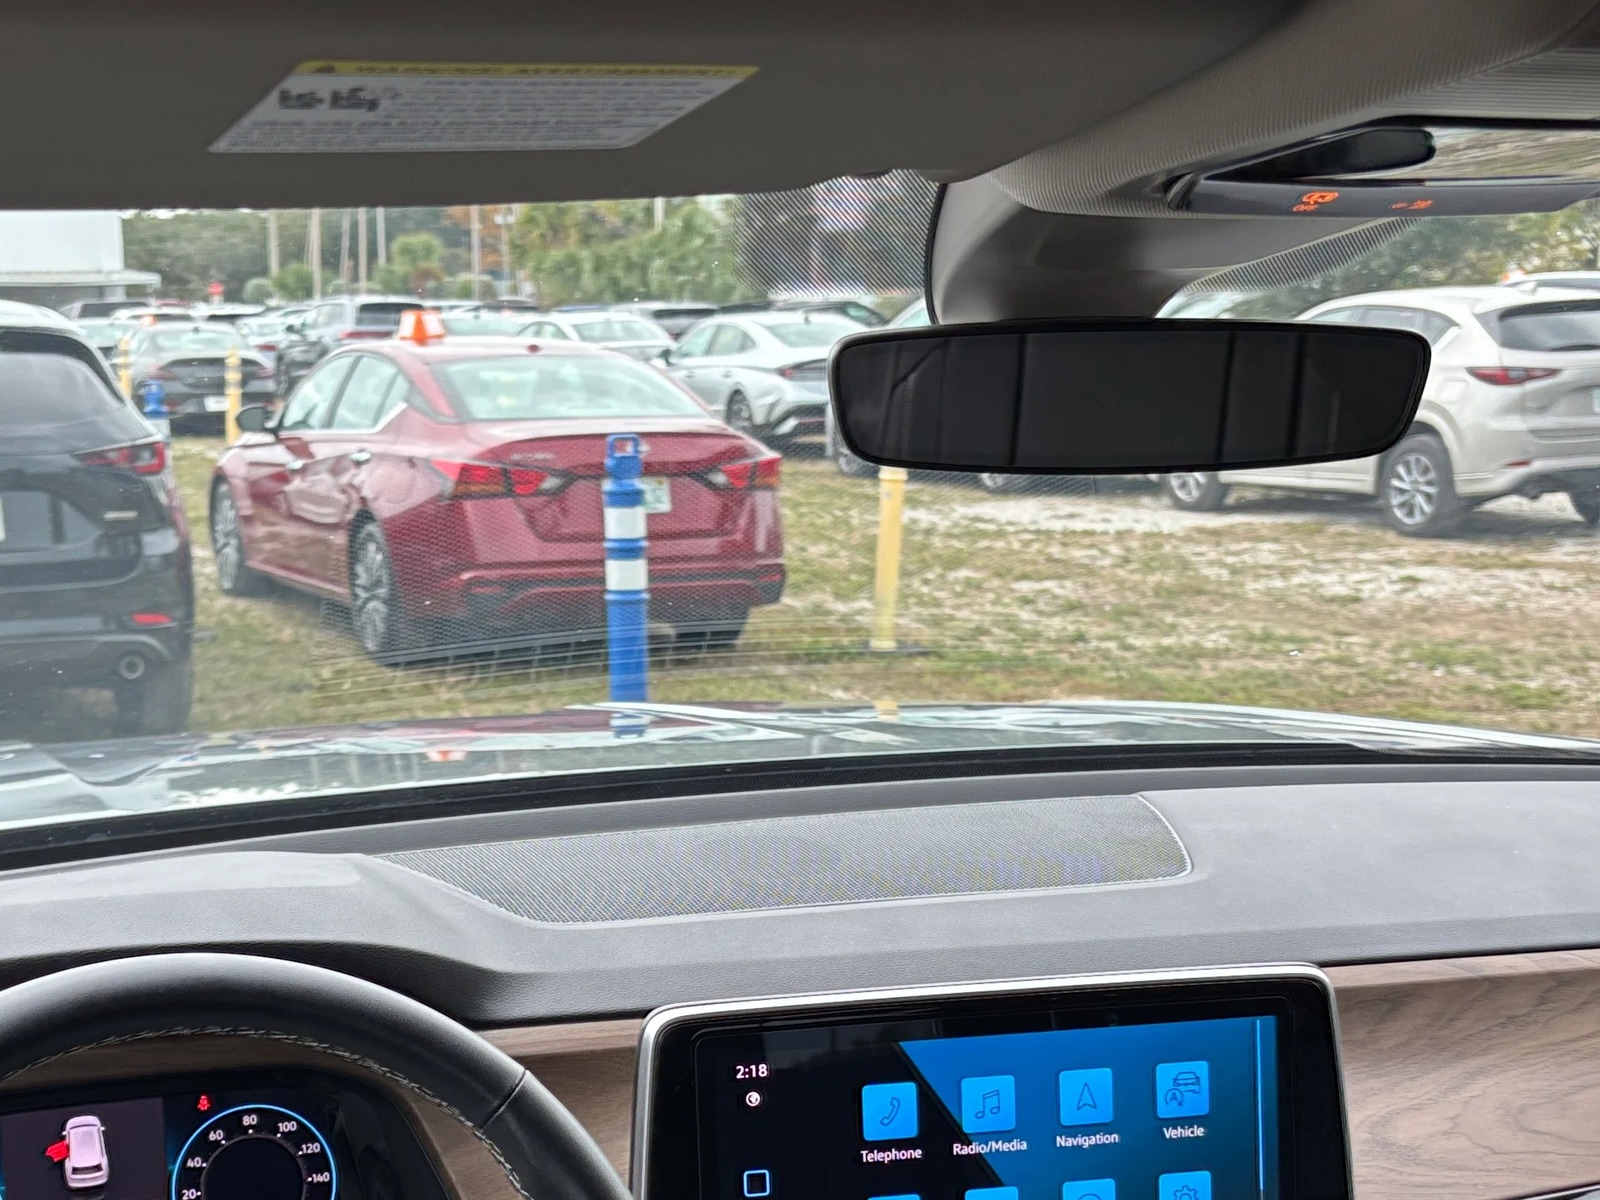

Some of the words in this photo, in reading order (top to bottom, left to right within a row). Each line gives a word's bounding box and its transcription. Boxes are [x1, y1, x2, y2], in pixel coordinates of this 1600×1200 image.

[735, 1063, 768, 1079] 2:18
[242, 1115, 257, 1126] 80
[278, 1121, 297, 1132] 100
[208, 1130, 224, 1141] 60
[1163, 1124, 1205, 1139] Vehicle
[1056, 1132, 1119, 1149] Navigation
[301, 1142, 321, 1154] 120
[952, 1138, 1028, 1156] Radio/Media
[860, 1148, 923, 1164] Telephone
[186, 1157, 202, 1168] 40
[312, 1172, 330, 1183] 140
[181, 1188, 197, 1200] 20
